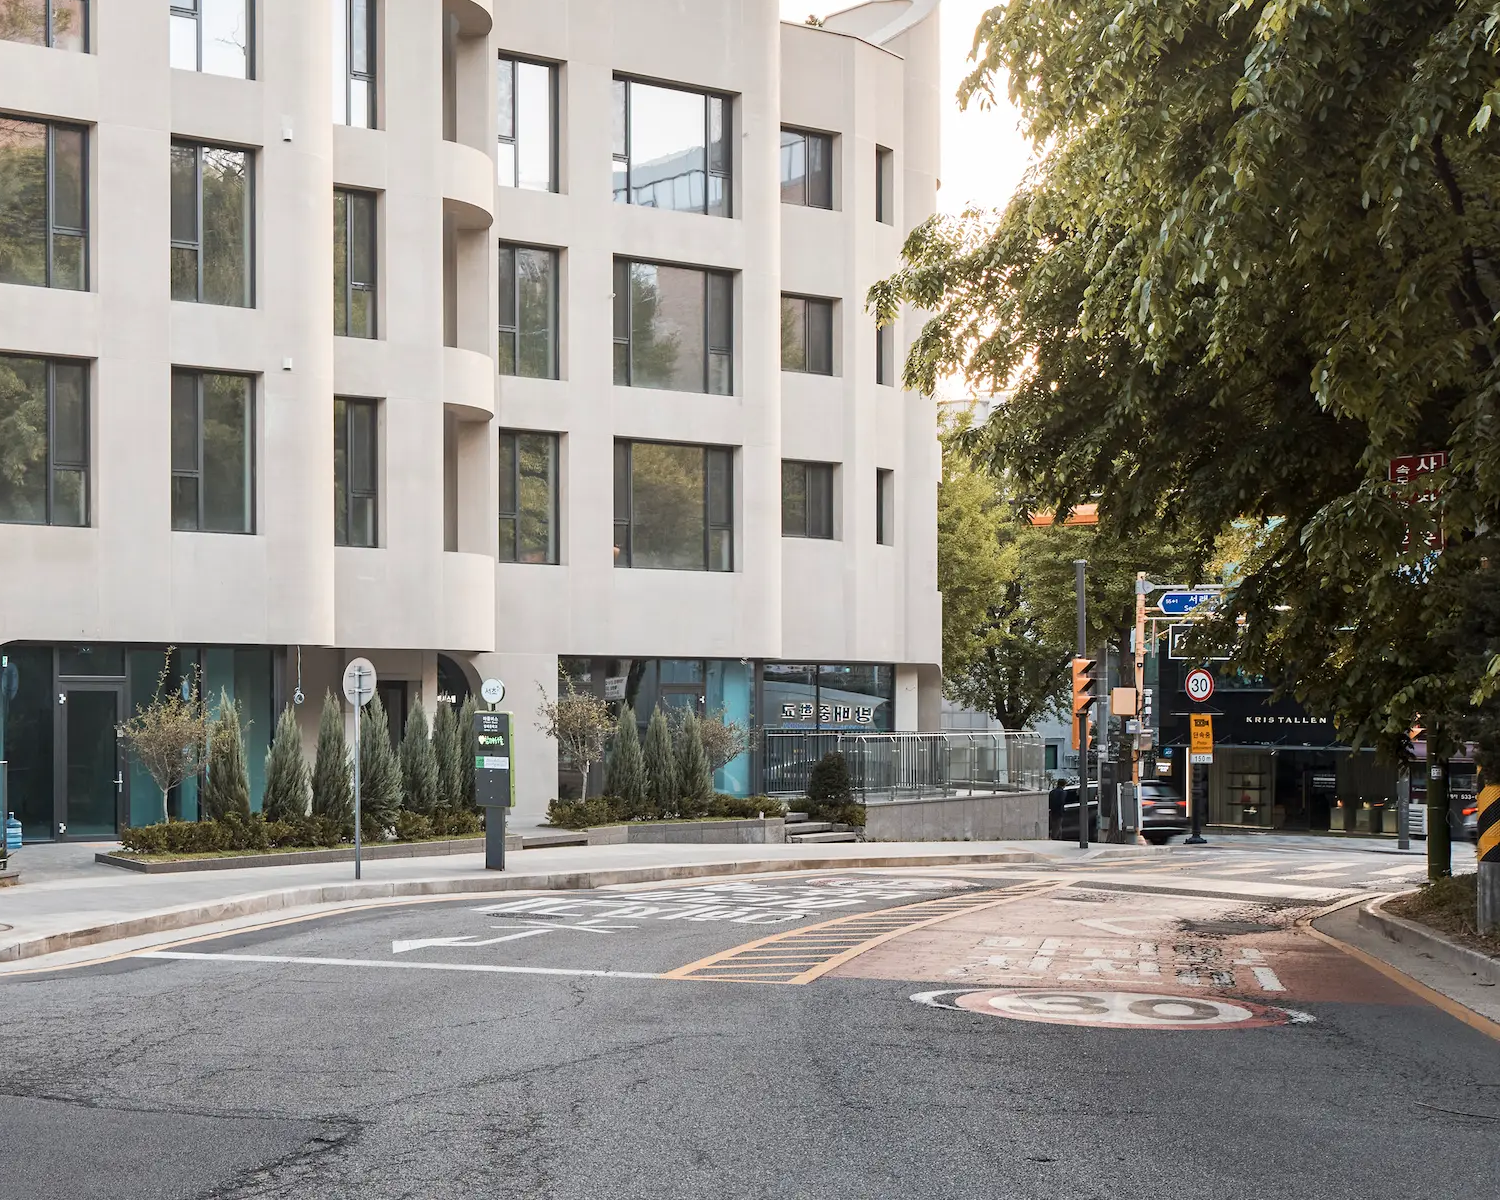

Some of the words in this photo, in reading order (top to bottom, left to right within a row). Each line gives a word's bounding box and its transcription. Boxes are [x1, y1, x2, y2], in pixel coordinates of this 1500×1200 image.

[1191, 678, 1208, 692] 30
[1245, 716, 1327, 724] KRISTALLEN
[470, 897, 821, 924] 우회전금지
